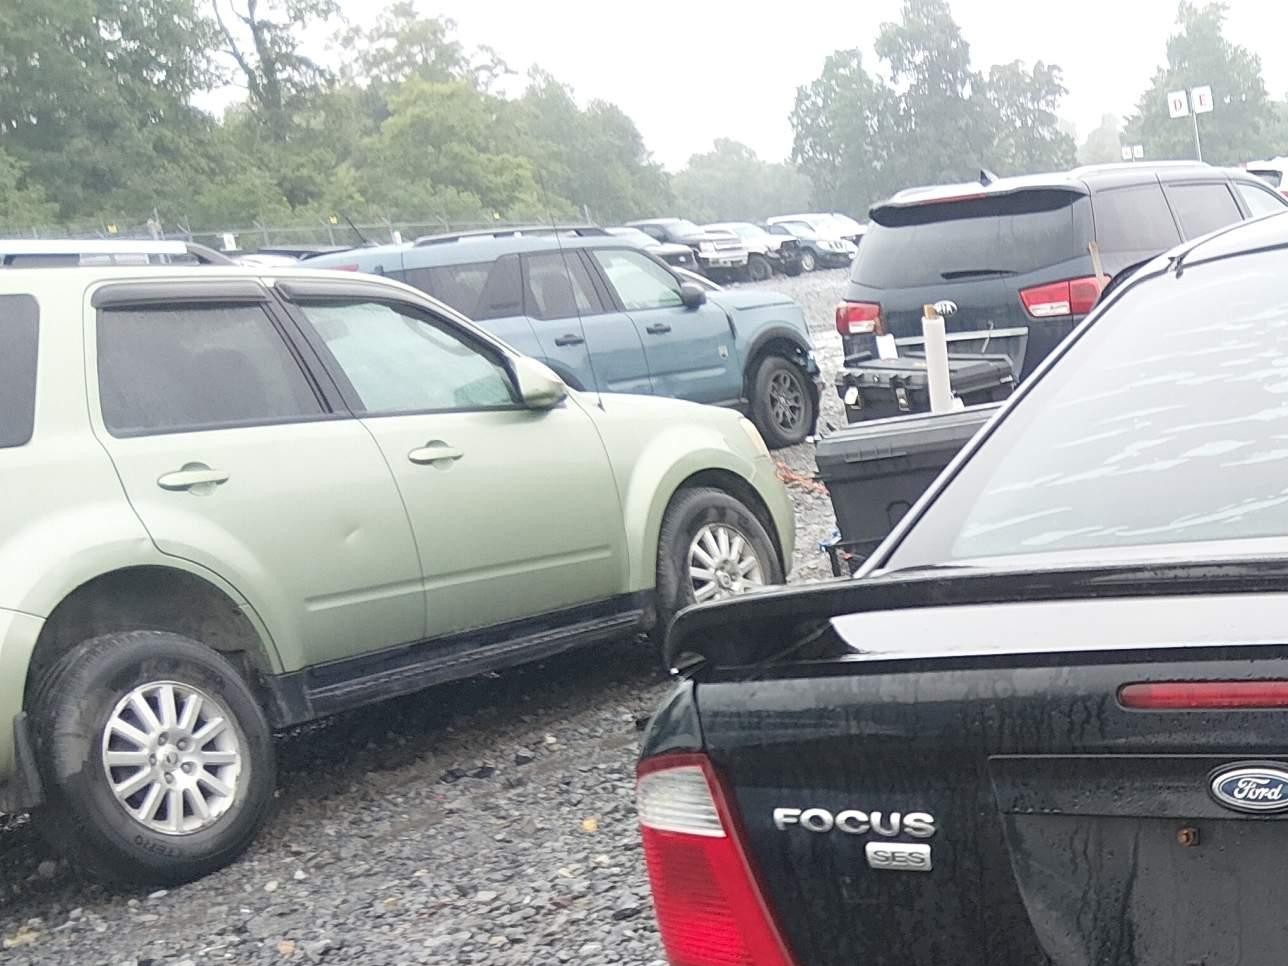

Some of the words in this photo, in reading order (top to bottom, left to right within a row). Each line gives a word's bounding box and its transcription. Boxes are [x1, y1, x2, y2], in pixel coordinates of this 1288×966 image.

[1233, 777, 1284, 801] Ford
[773, 807, 936, 838] FOCUS
[871, 849, 926, 867] SES
